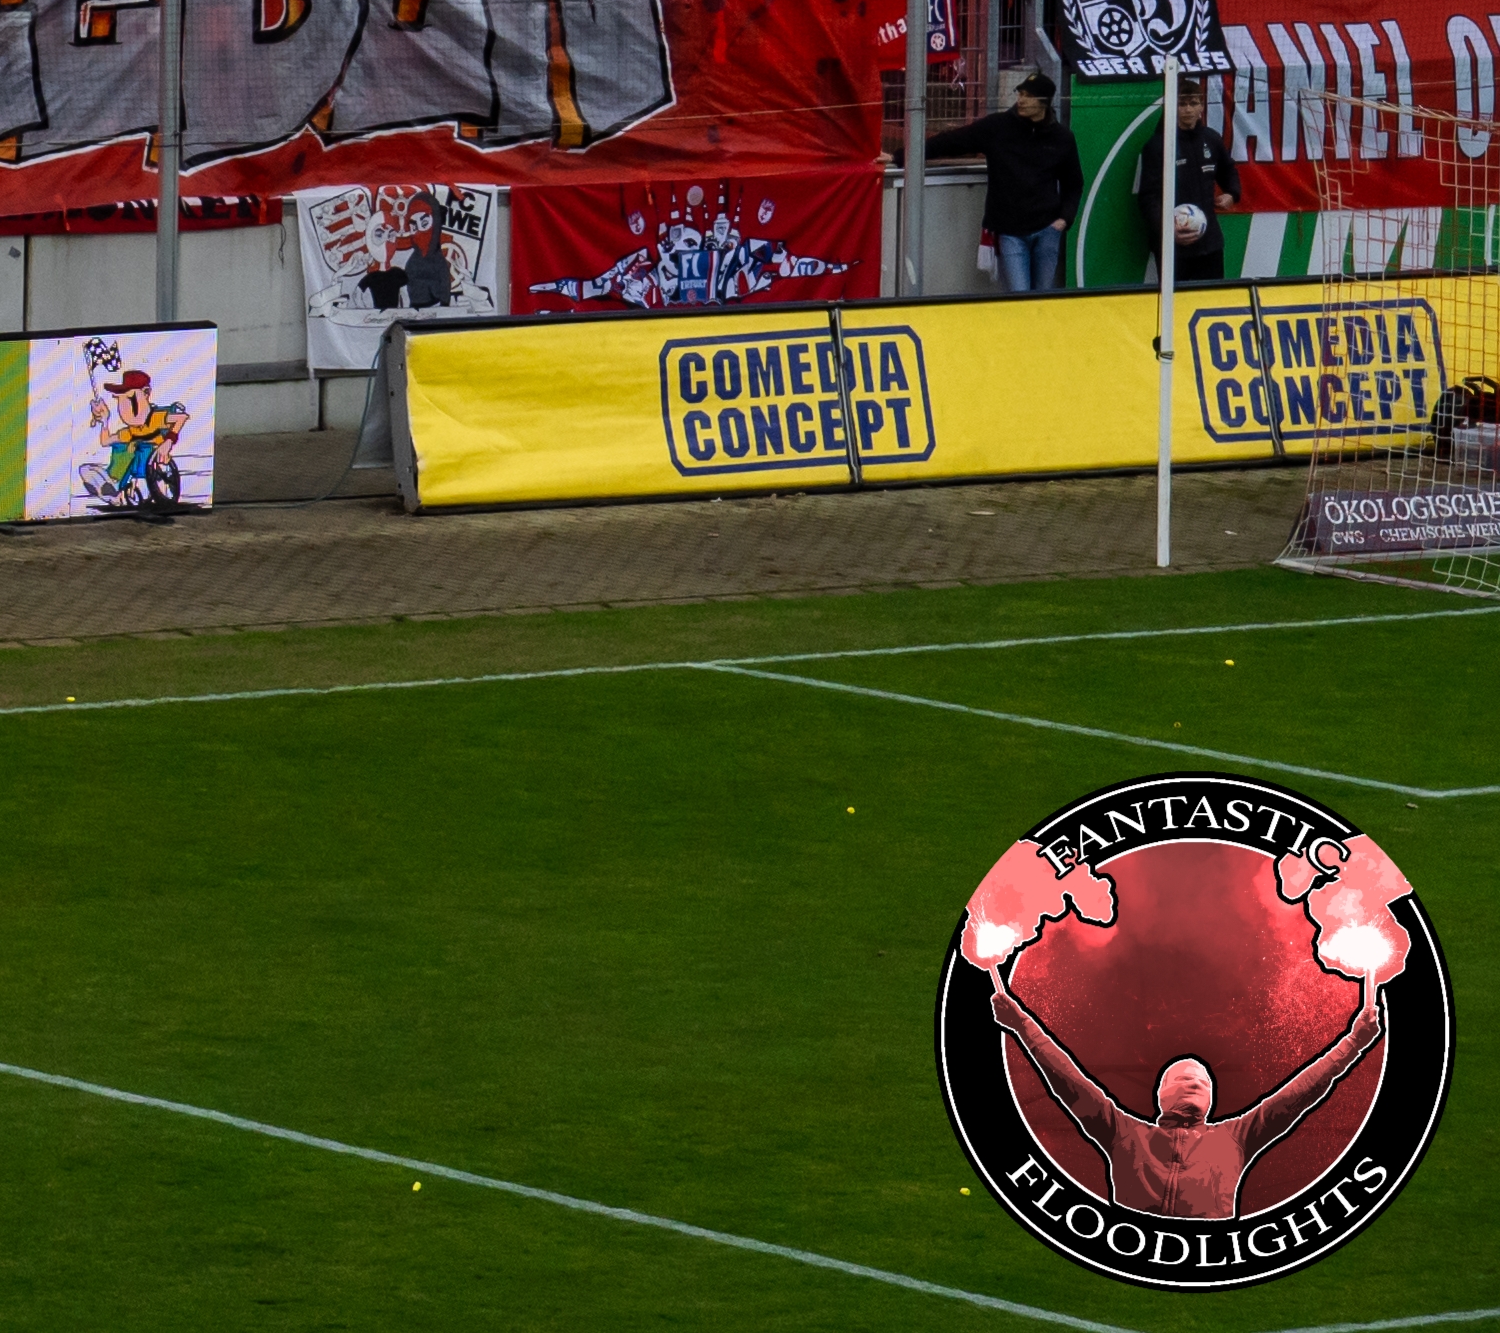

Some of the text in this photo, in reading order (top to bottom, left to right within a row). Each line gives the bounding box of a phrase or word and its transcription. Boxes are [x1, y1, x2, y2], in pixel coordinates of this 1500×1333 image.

[1077, 55, 1149, 77] ÜBER
[678, 340, 910, 404] COMEDIA
[1207, 313, 1426, 372] COMEDIA
[1216, 368, 1428, 428] CONCEPT
[683, 397, 912, 461] CONCEPT
[1332, 530, 1365, 545] CWS
[1380, 524, 1466, 543] CHEMISCHE
